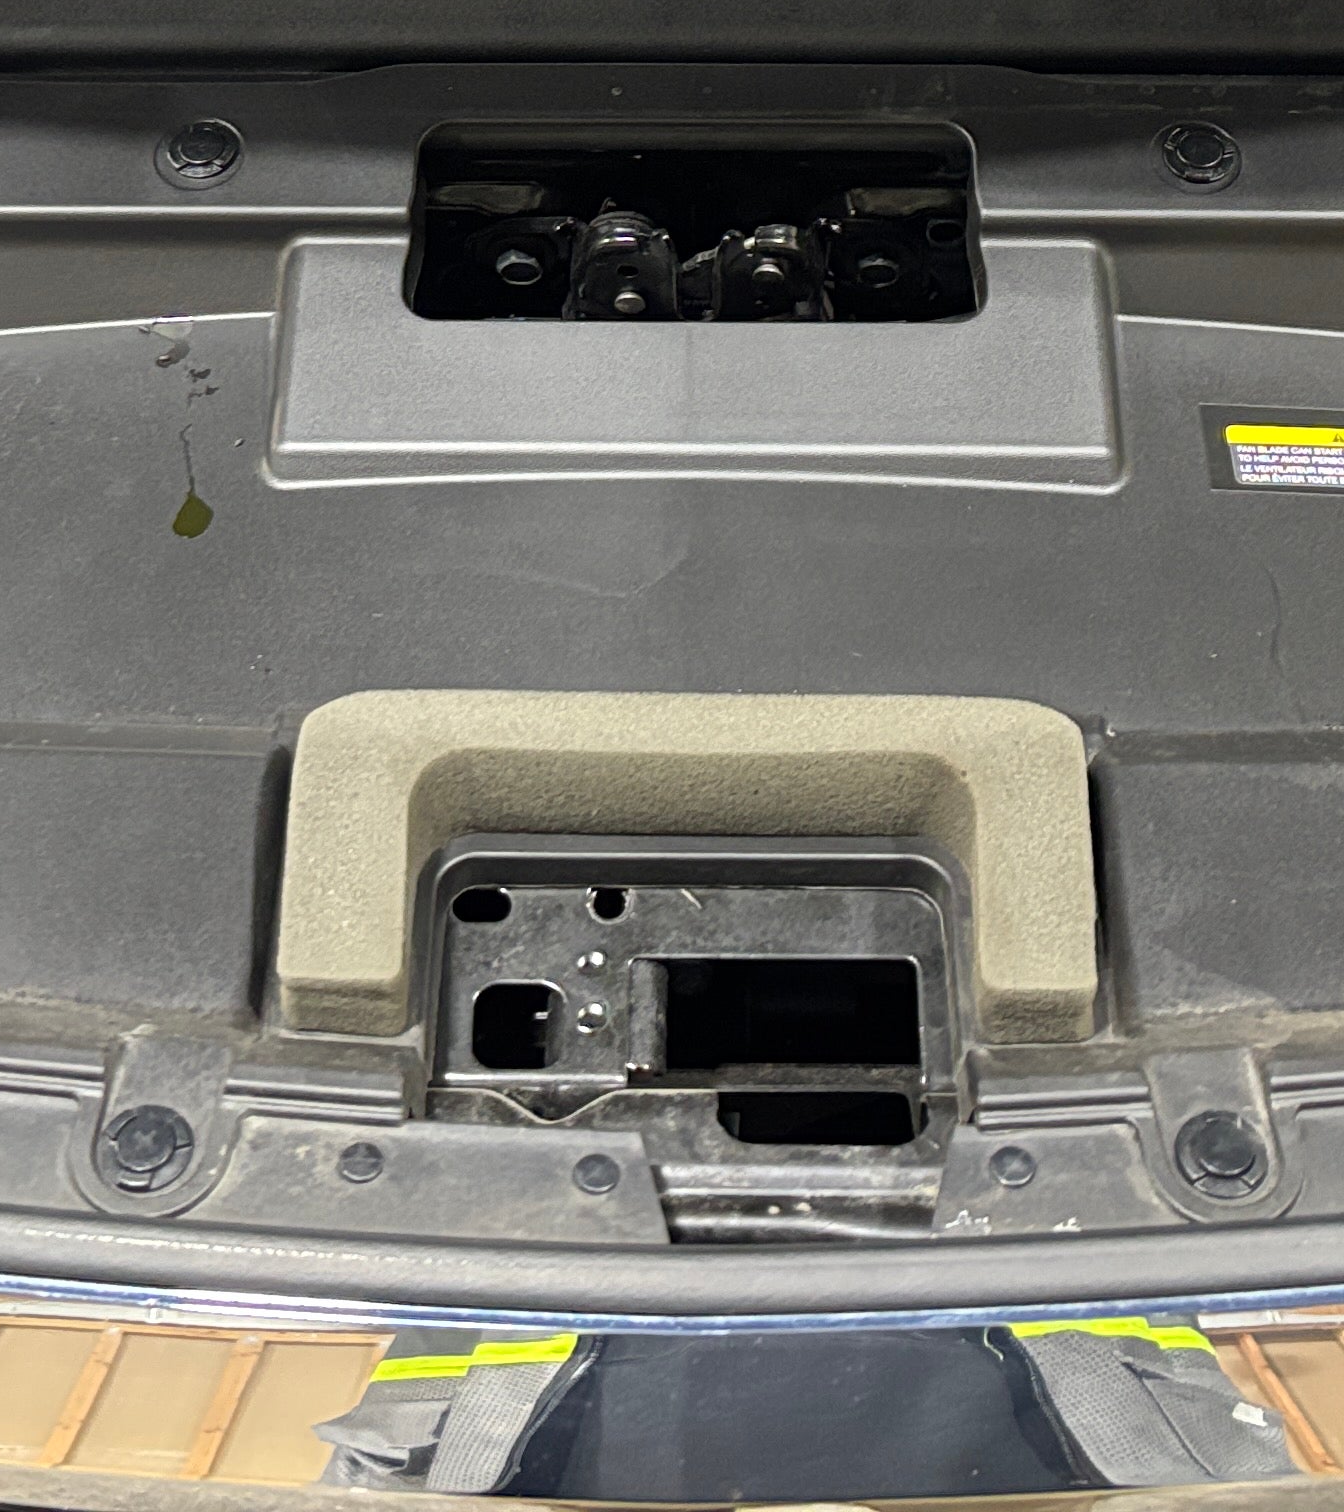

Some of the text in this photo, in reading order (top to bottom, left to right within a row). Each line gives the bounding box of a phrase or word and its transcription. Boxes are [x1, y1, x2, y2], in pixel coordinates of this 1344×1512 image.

[1236, 445, 1256, 453] FAN
[1257, 446, 1289, 454] BLADE
[1290, 447, 1312, 455] CAN
[1313, 447, 1343, 456] START
[1238, 454, 1253, 462] TO
[1254, 454, 1279, 463] HELP
[1280, 455, 1310, 464] AVOID
[1239, 465, 1253, 473] LE
[1241, 473, 1271, 482] POUR
